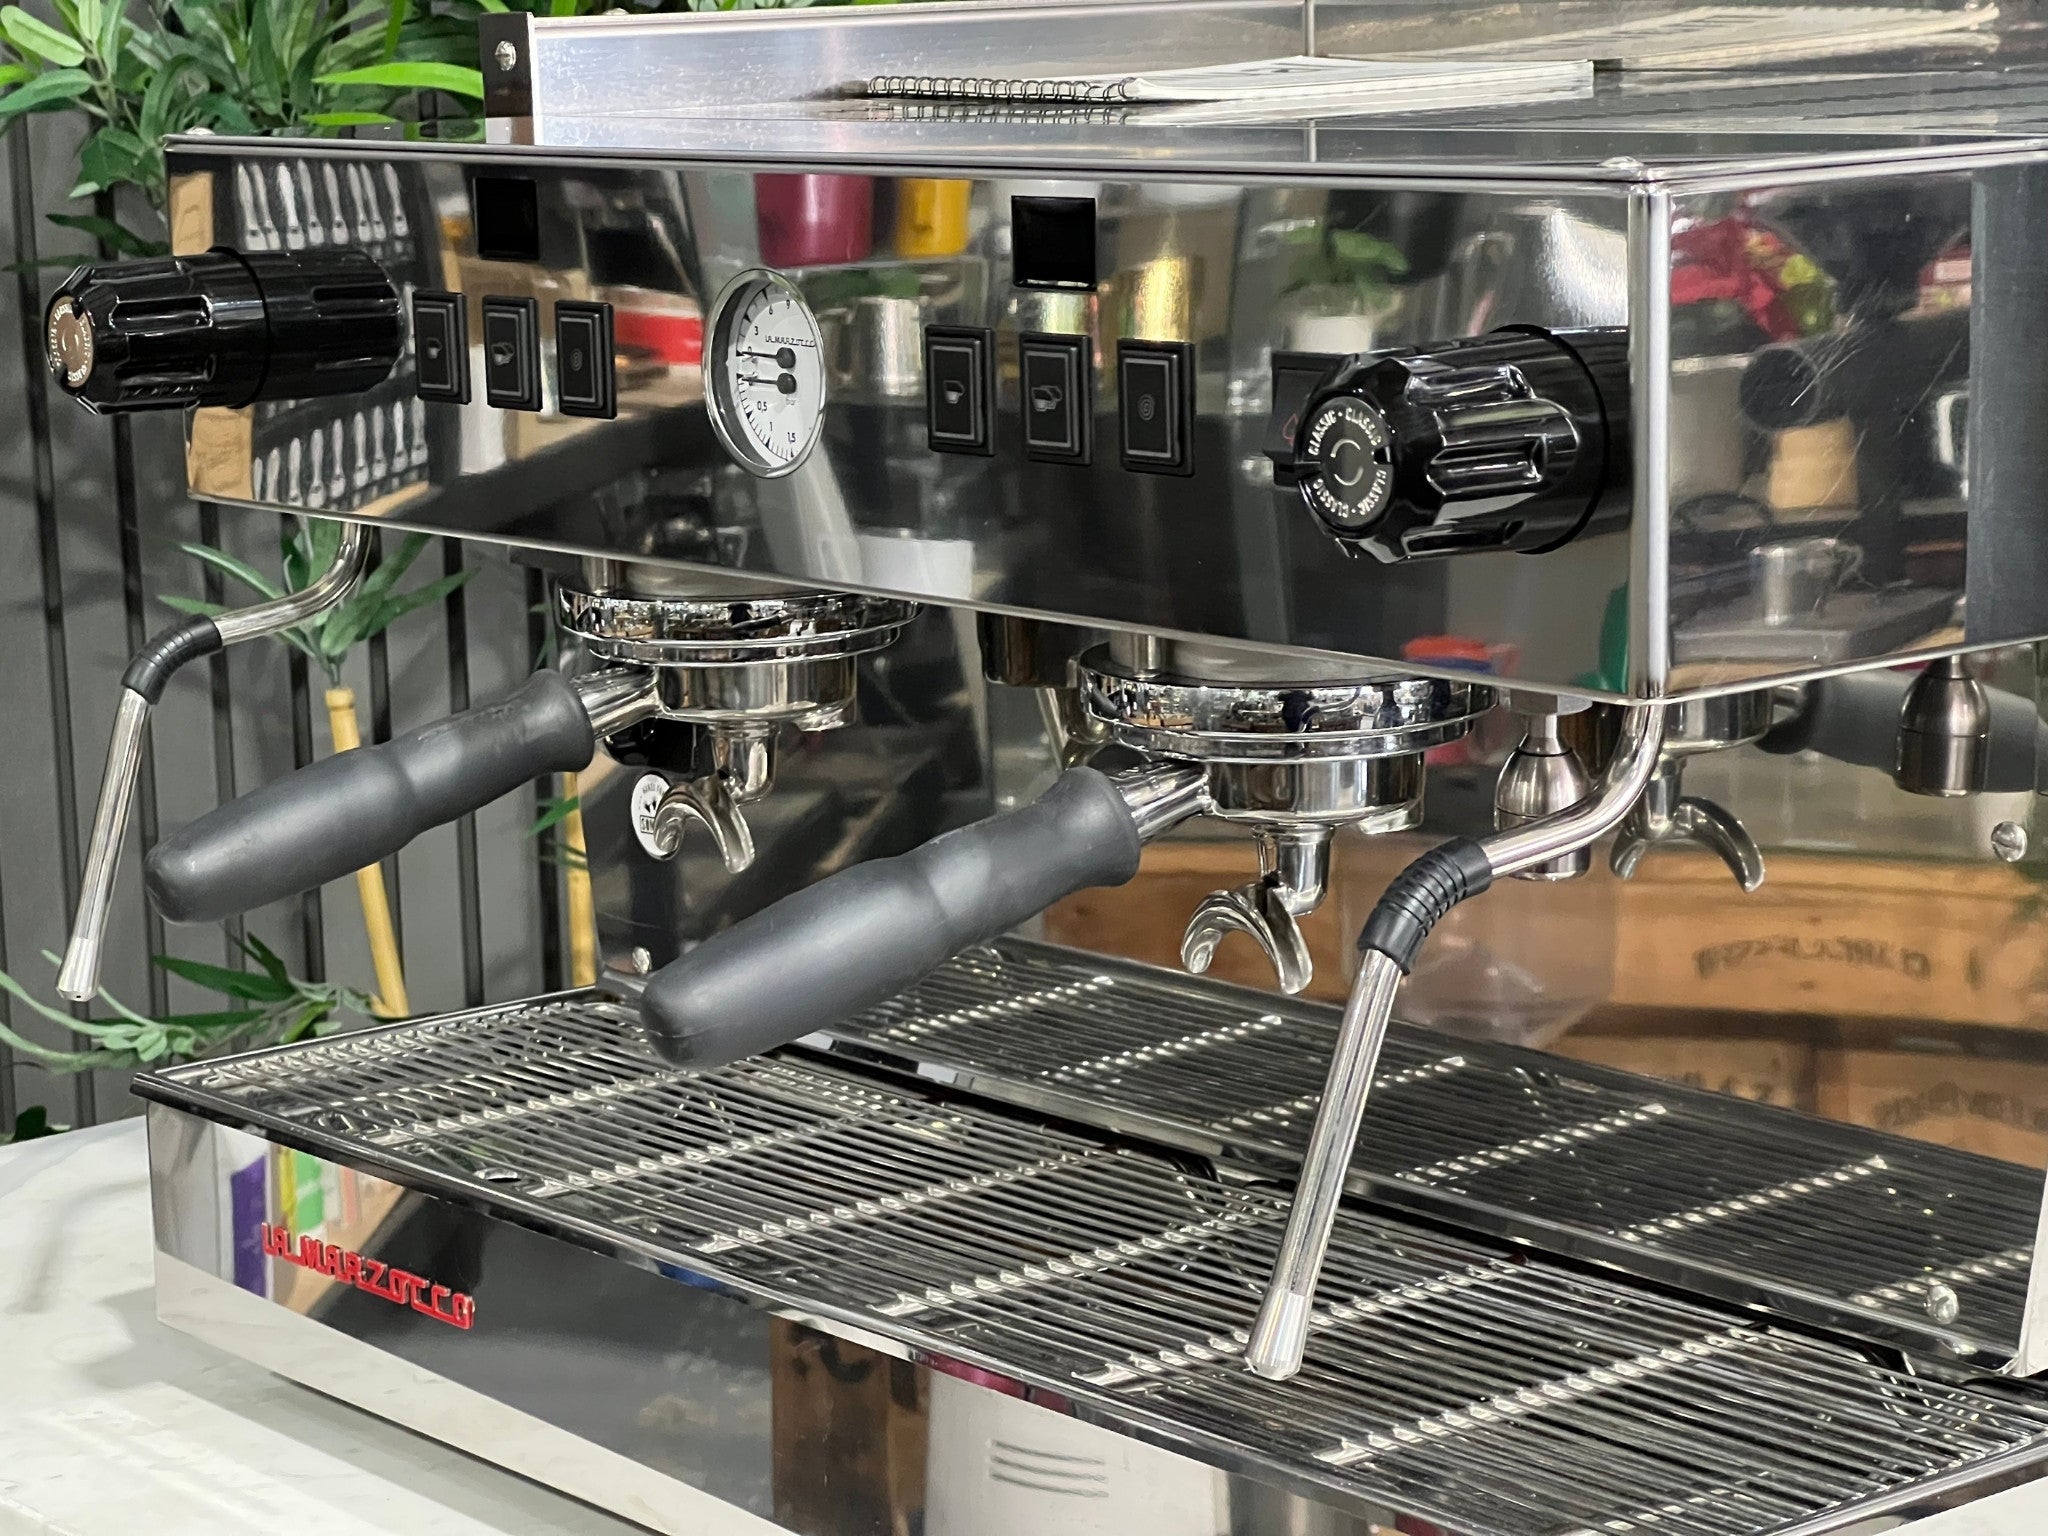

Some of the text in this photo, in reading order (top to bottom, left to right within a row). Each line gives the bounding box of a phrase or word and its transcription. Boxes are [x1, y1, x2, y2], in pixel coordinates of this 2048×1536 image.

[768, 306, 774, 316] 6
[754, 326, 759, 336] 3
[1308, 407, 1382, 456] CLASSIC CLASSIC
[261, 1221, 476, 1330] LA MARZOCCO
